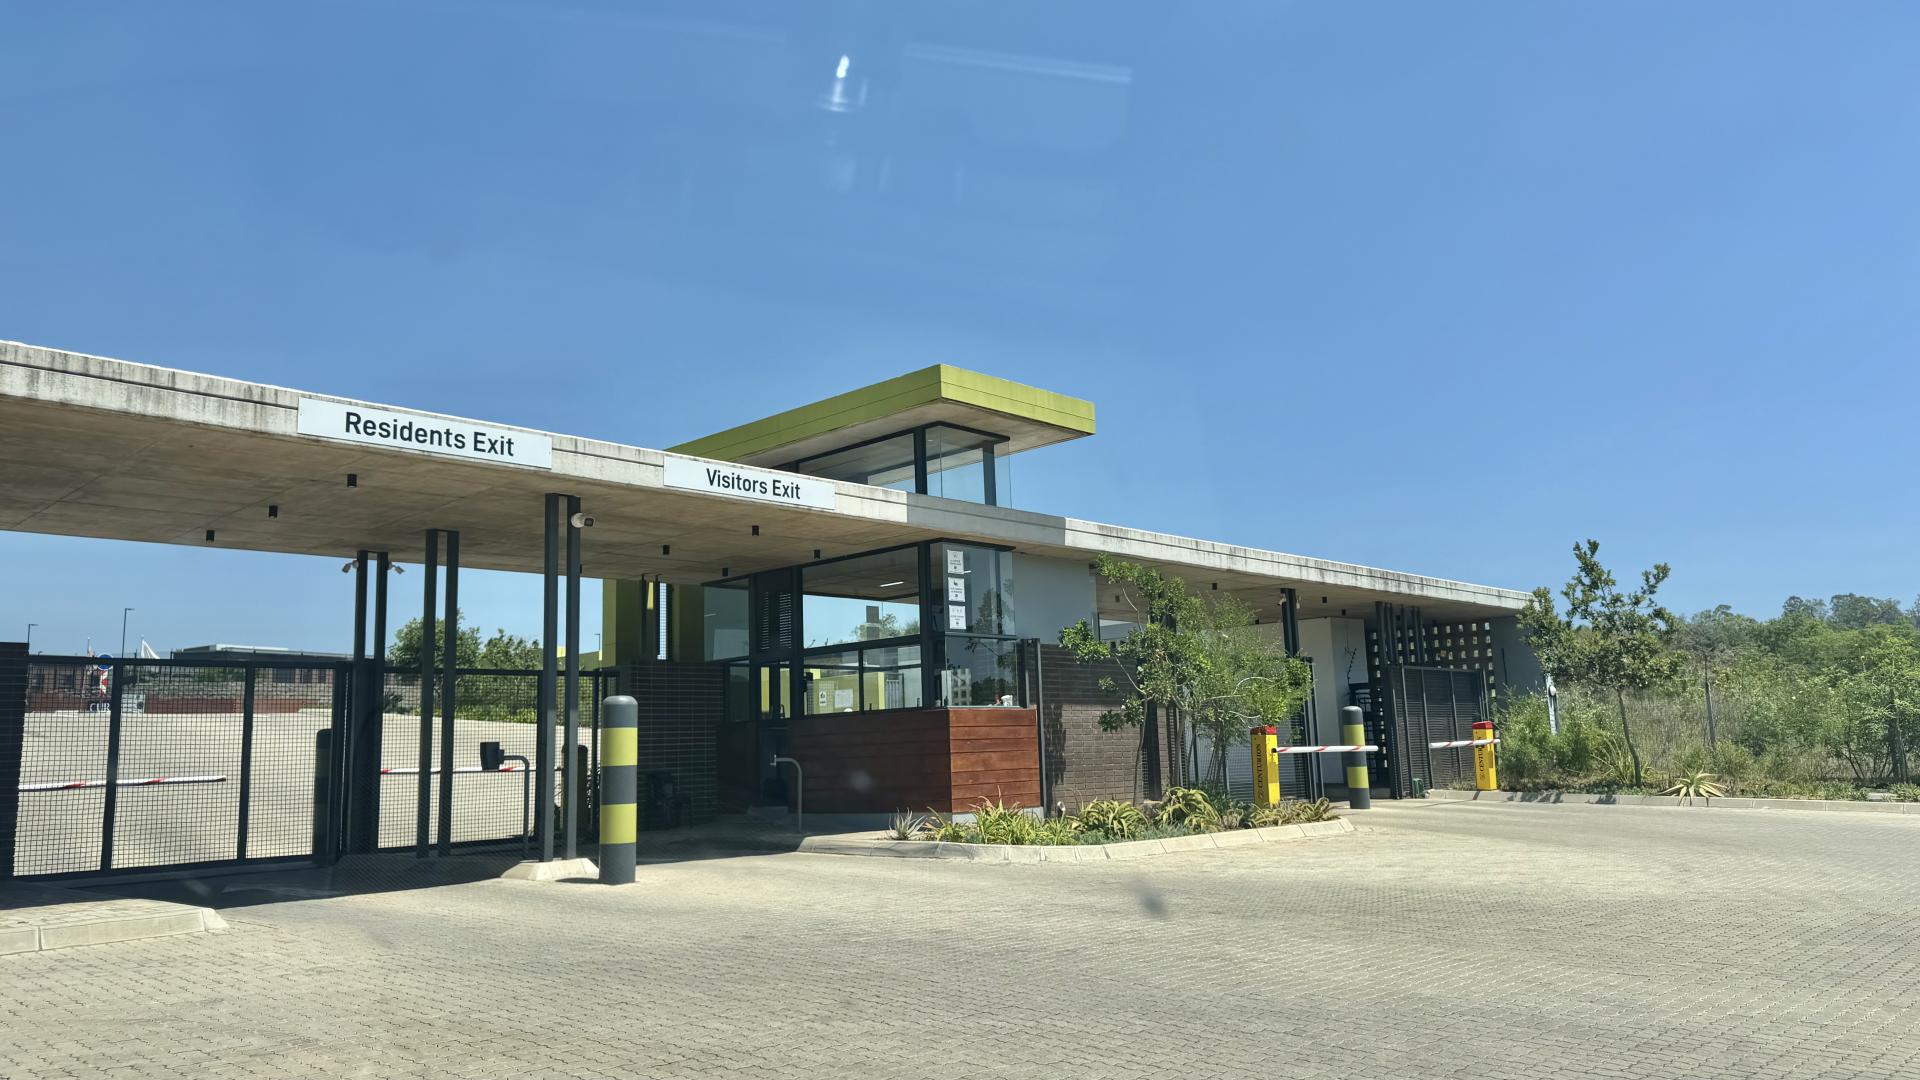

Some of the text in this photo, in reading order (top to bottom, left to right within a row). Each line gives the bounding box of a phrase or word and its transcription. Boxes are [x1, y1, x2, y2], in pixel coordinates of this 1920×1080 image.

[345, 411, 514, 456] Residents Exit
[706, 468, 800, 499] Visitors Exit
